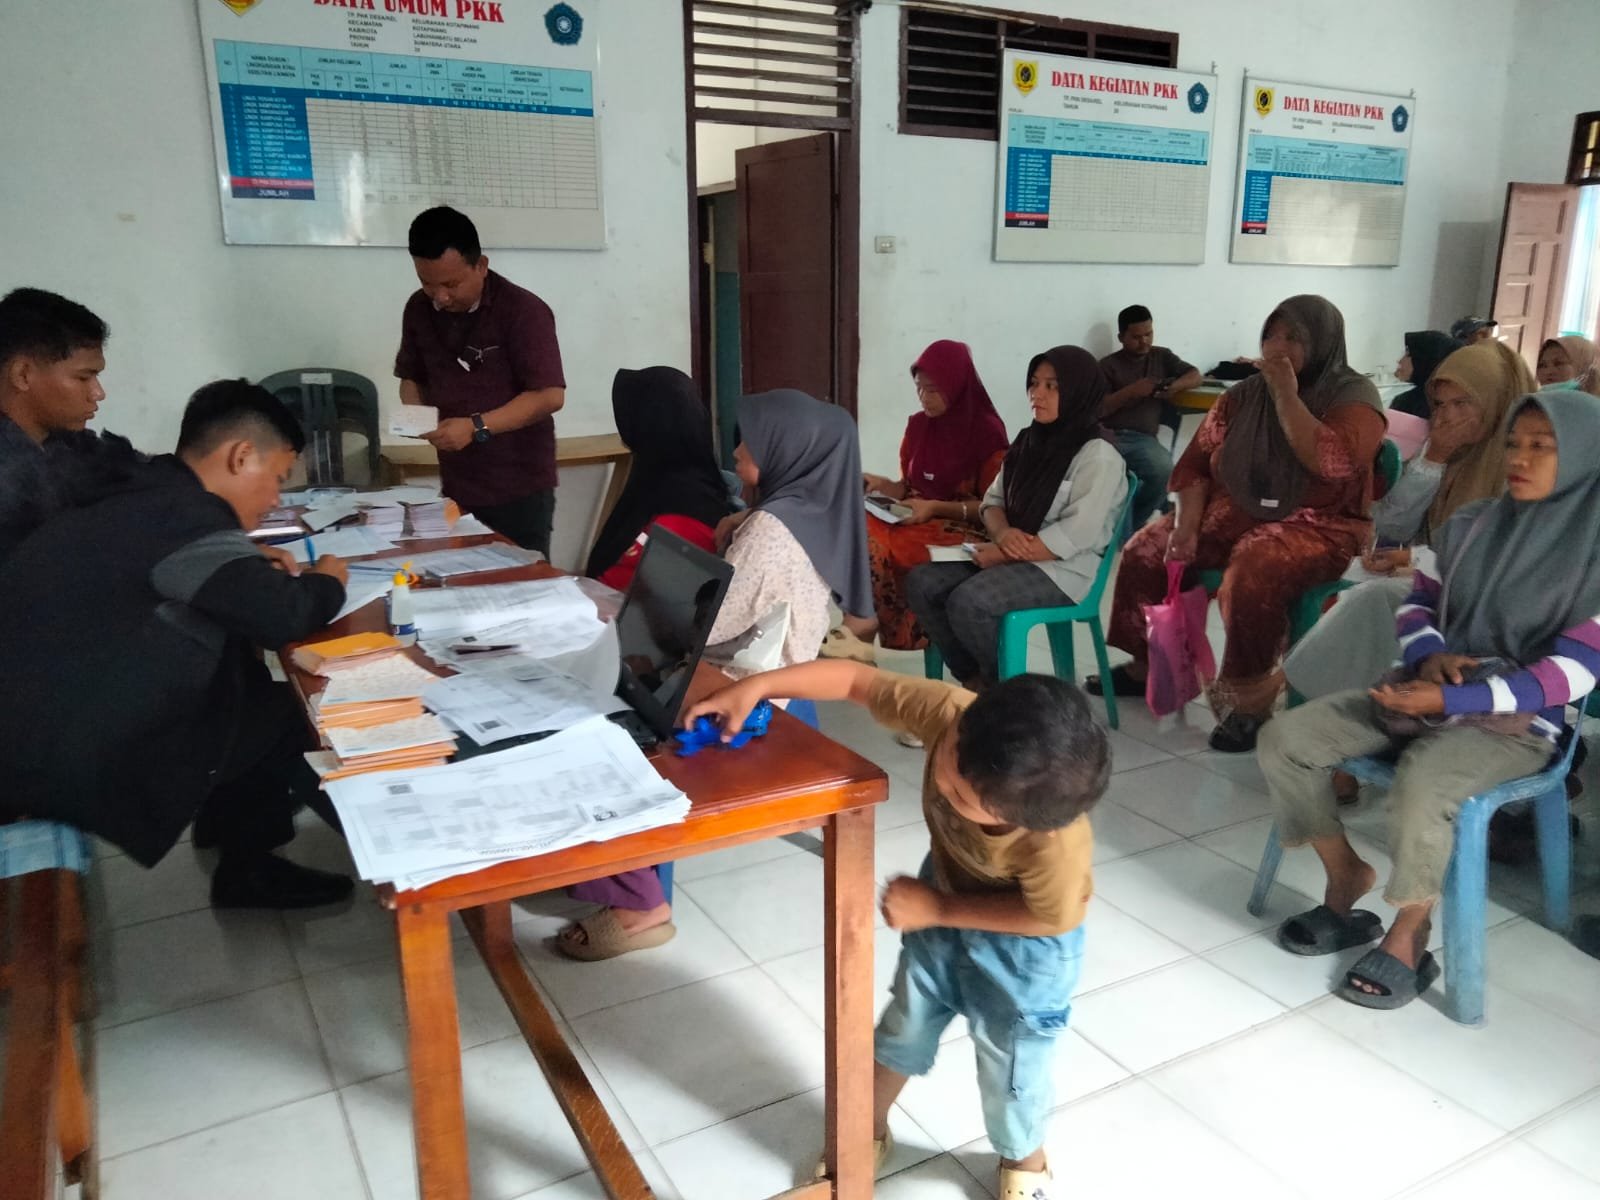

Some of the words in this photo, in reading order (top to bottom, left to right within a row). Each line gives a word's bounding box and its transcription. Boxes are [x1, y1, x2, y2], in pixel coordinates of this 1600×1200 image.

[313, 0, 375, 10] TA
[384, 0, 448, 17] UMUM
[456, 0, 504, 23] PKK
[348, 19, 383, 27] KECAMATAN
[414, 40, 443, 48] SUMATERA
[1052, 70, 1085, 90] DATA
[1090, 75, 1149, 96] KEGIATAN
[1153, 82, 1178, 100] PKK
[1284, 96, 1310, 112] DATA
[1314, 99, 1360, 118] KEGIATAN
[1364, 106, 1384, 120] PKK
